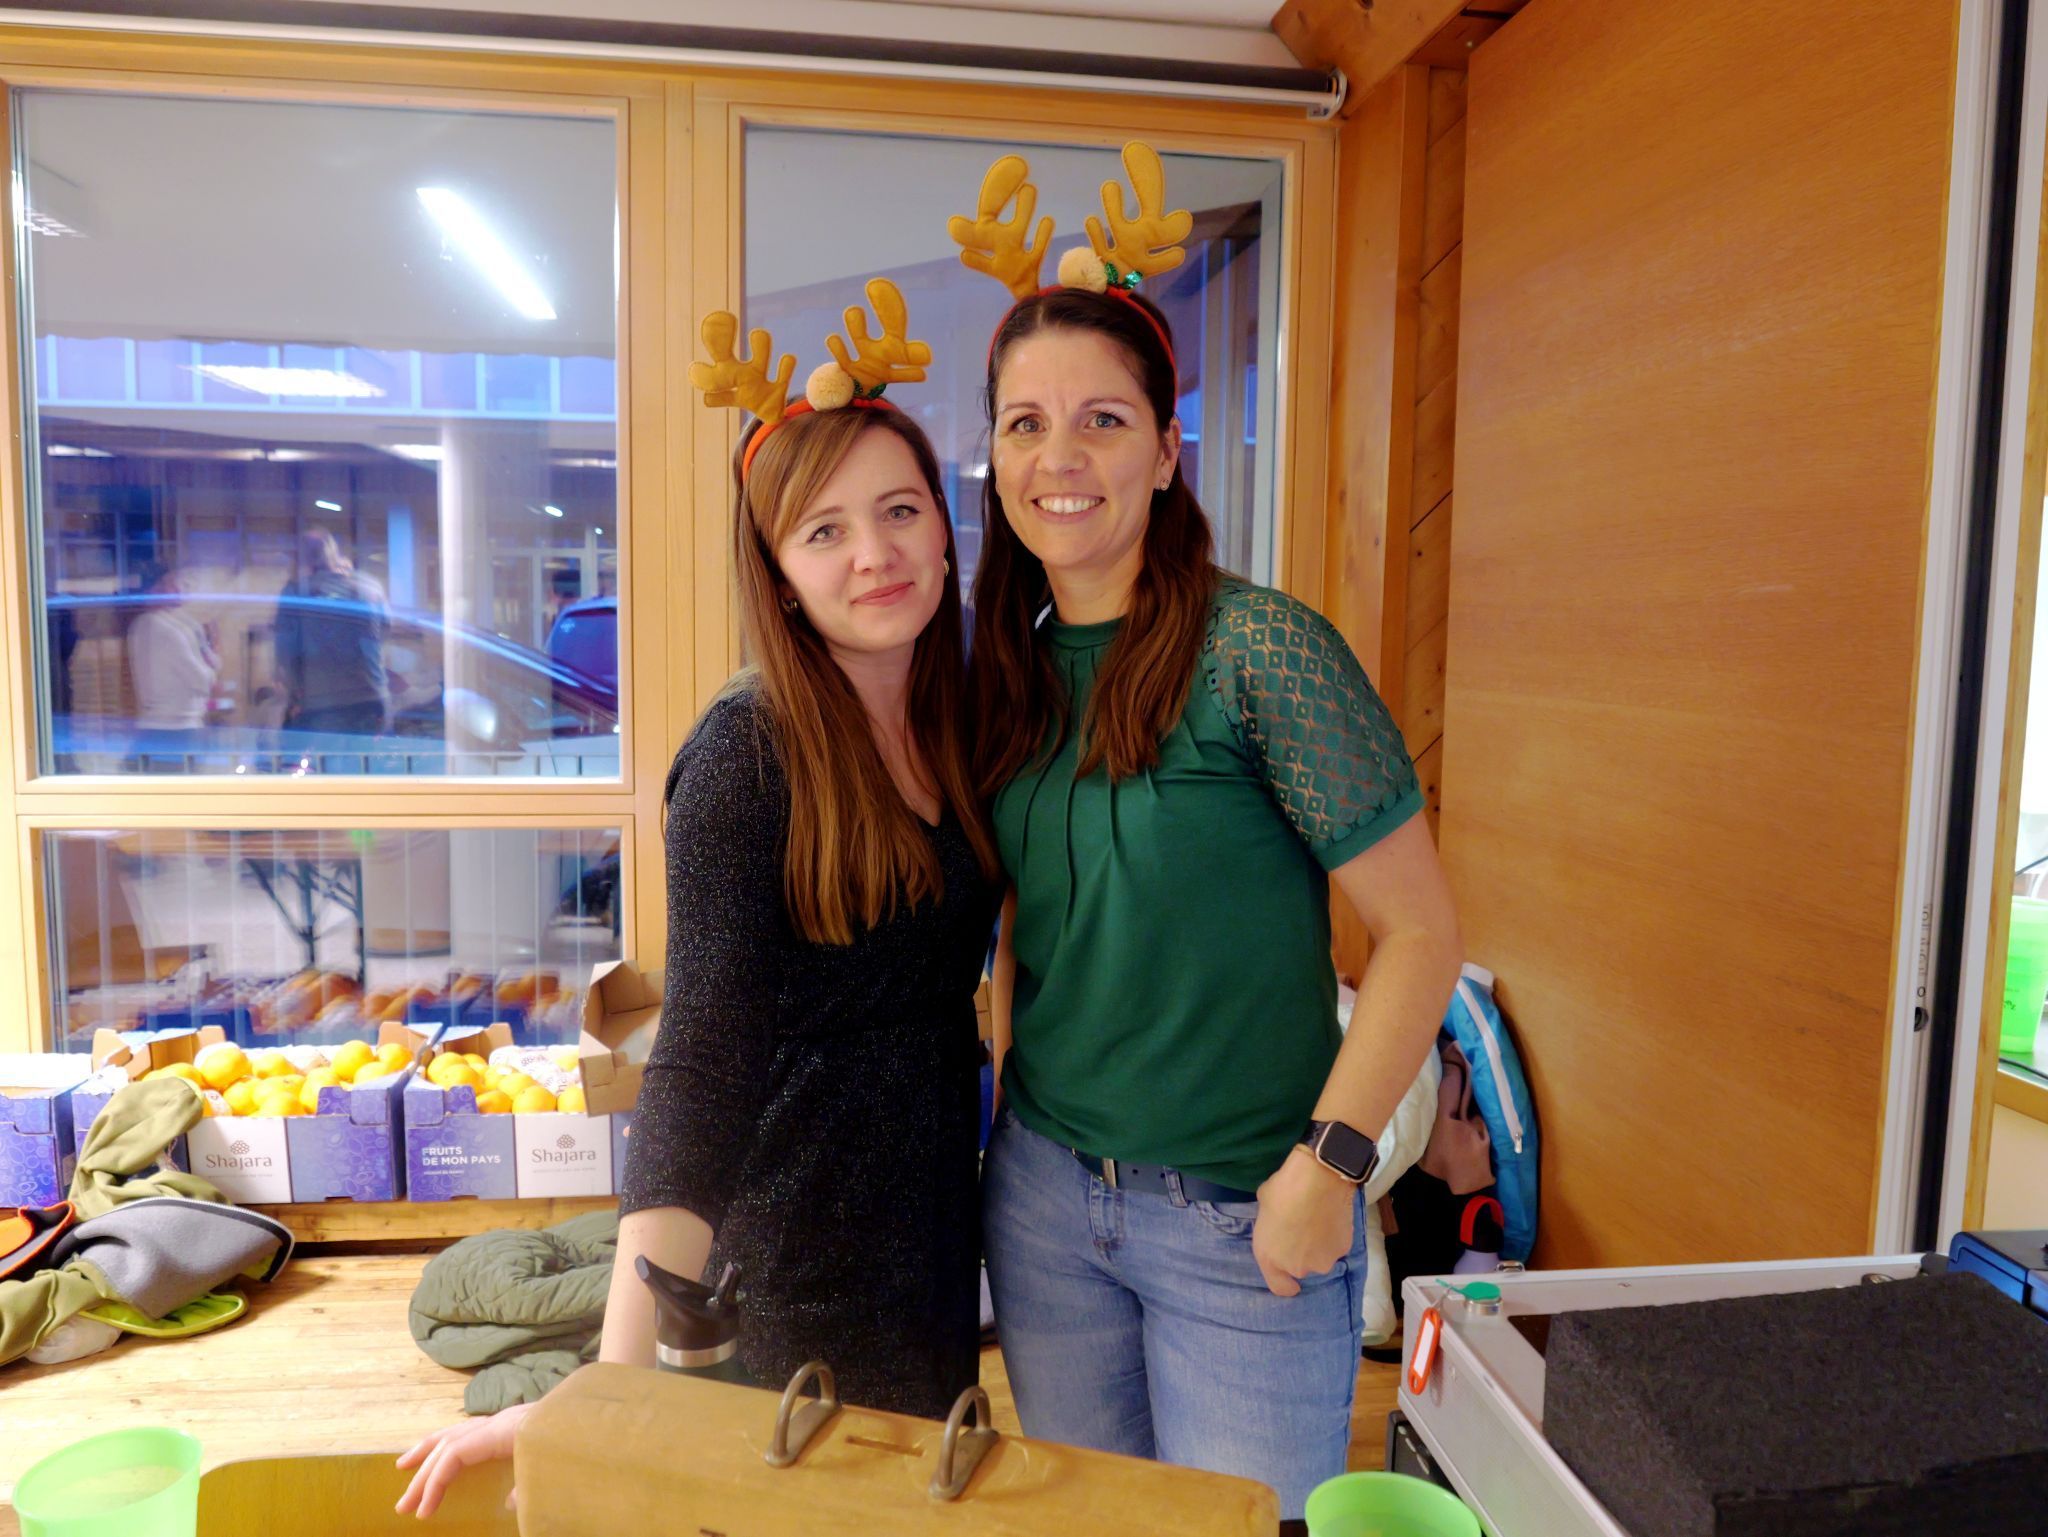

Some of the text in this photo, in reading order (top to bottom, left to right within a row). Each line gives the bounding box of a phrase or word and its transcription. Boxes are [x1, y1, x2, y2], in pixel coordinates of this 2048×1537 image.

[422, 1146, 462, 1156] FRUITS
[531, 1148, 597, 1165] Shajara
[205, 1153, 273, 1170] Shajara
[422, 1155, 501, 1166] DE MON PAYS
